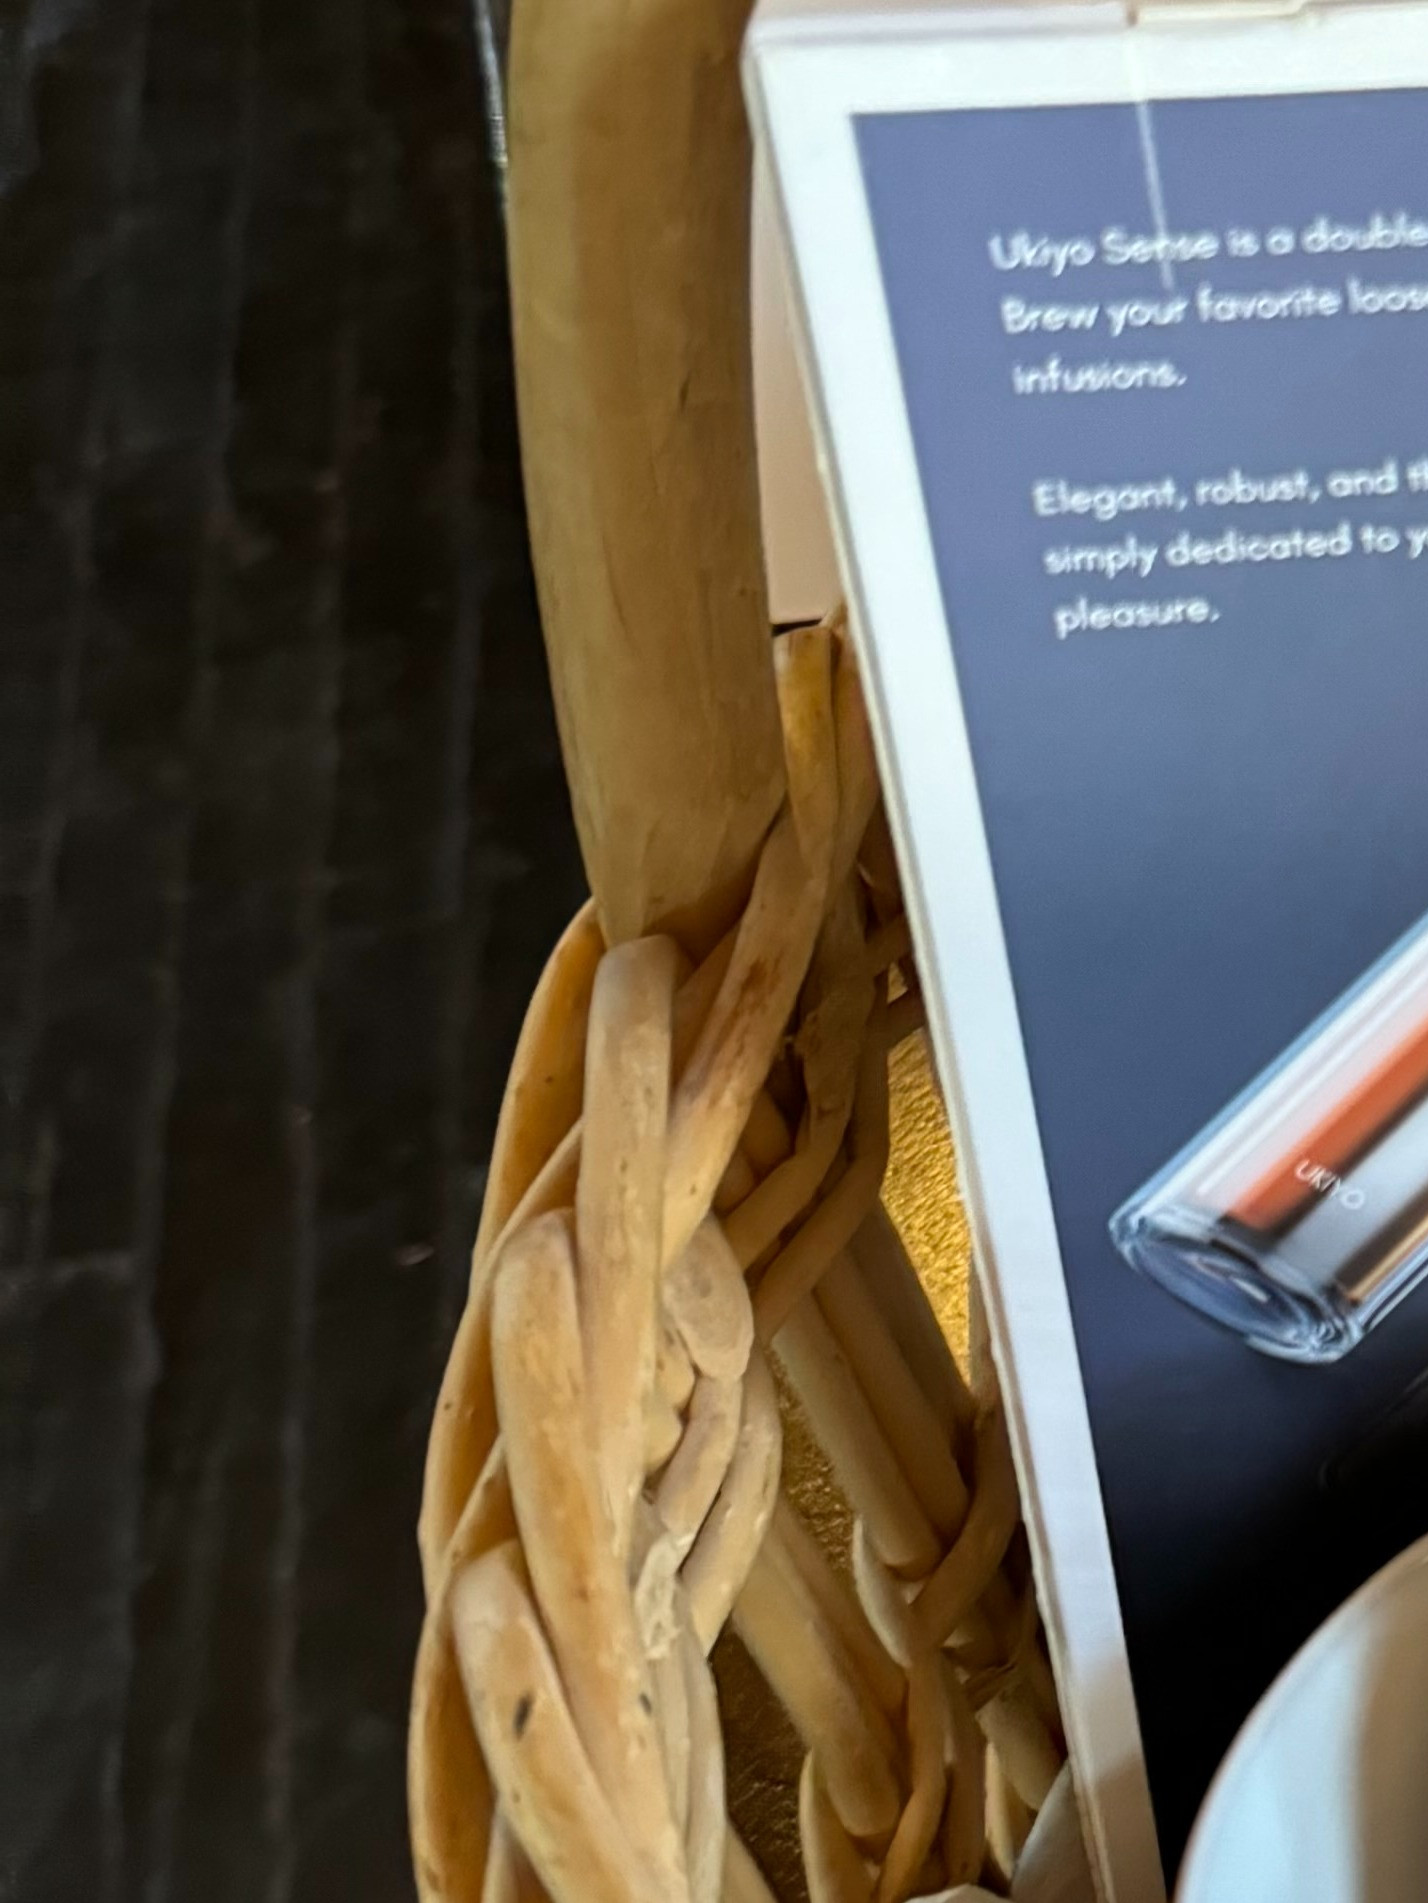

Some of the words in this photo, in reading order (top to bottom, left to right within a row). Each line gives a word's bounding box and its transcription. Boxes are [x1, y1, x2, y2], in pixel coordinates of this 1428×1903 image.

[989, 229, 1096, 278] Ukiyo
[1101, 224, 1220, 265] Sense
[1226, 227, 1260, 257] is
[1265, 226, 1295, 255] a
[1001, 296, 1099, 334] Brew
[1105, 298, 1188, 337] your
[1196, 281, 1341, 322] favorite
[1012, 352, 1187, 395] infusions.
[1031, 476, 1189, 520] Elegant,
[1195, 467, 1322, 506] robust,
[1326, 456, 1399, 498] and
[1044, 533, 1158, 579] simply
[1165, 519, 1353, 567] dedicated
[1359, 523, 1400, 554] to
[1295, 1159, 1365, 1210] UKIYO
